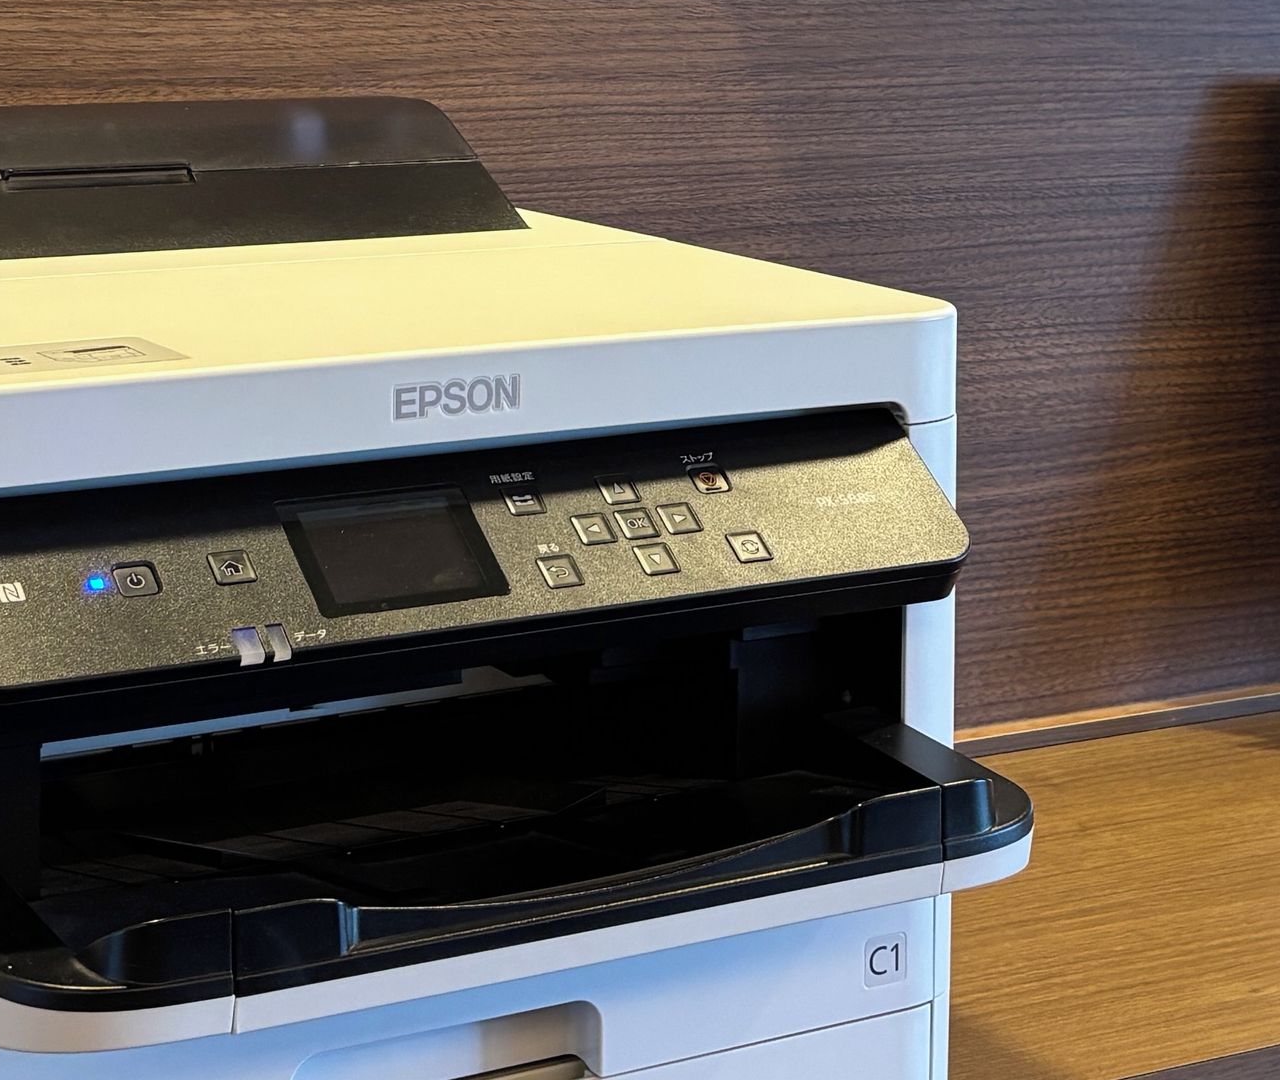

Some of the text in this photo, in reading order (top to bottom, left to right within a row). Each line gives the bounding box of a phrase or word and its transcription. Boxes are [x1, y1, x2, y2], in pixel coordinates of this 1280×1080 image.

[394, 375, 519, 420] EPSON
[680, 452, 713, 463] ストップ
[489, 472, 535, 485] 用紙設定
[626, 517, 649, 529] OK
[537, 542, 559, 554] 戻る
[294, 629, 327, 641] データ
[196, 643, 231, 655] エラー
[869, 943, 899, 975] C1
